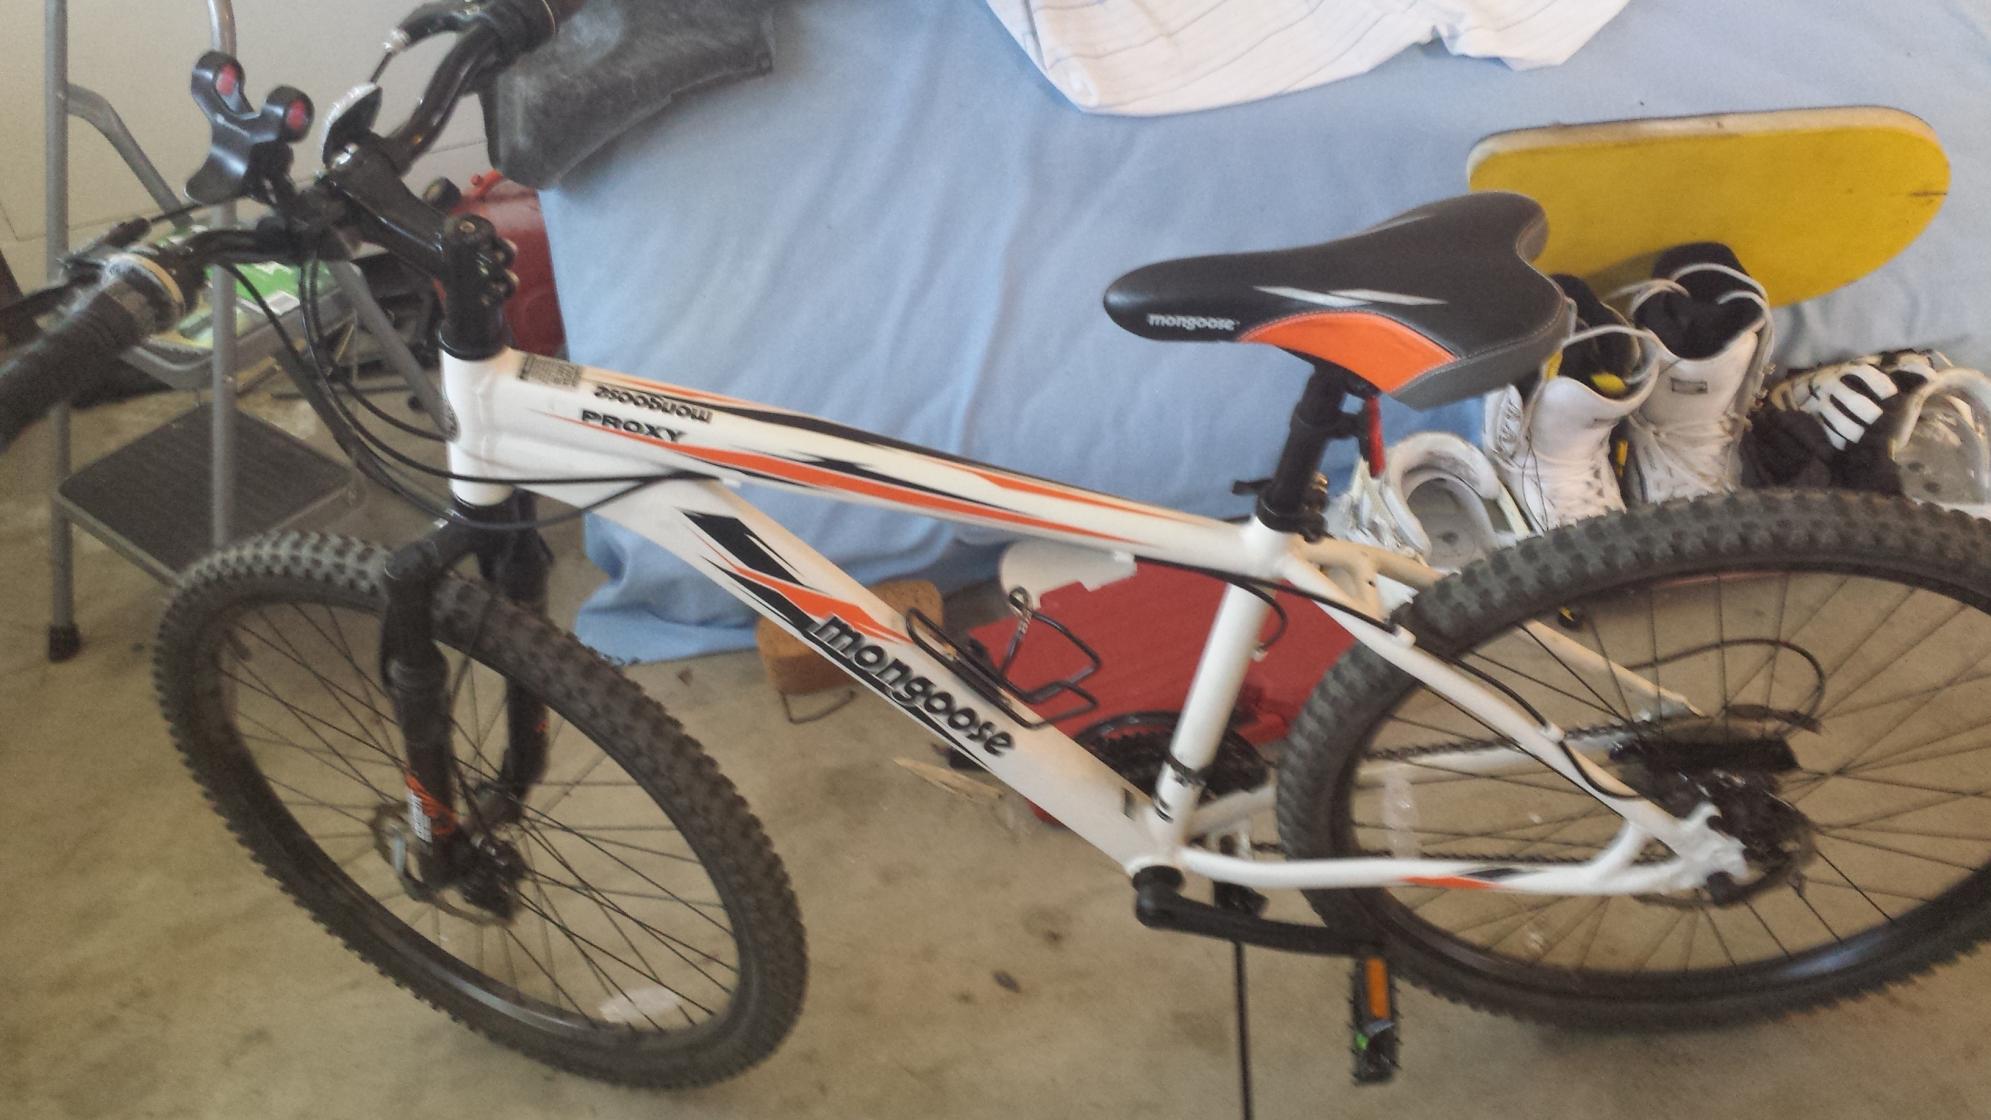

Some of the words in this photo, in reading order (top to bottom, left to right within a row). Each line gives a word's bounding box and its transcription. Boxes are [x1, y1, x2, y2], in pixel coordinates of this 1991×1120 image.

[1148, 314, 1236, 331] mongoose
[593, 385, 713, 423] mongoose
[581, 409, 686, 442] PROXY
[804, 614, 1014, 756] mongoose
